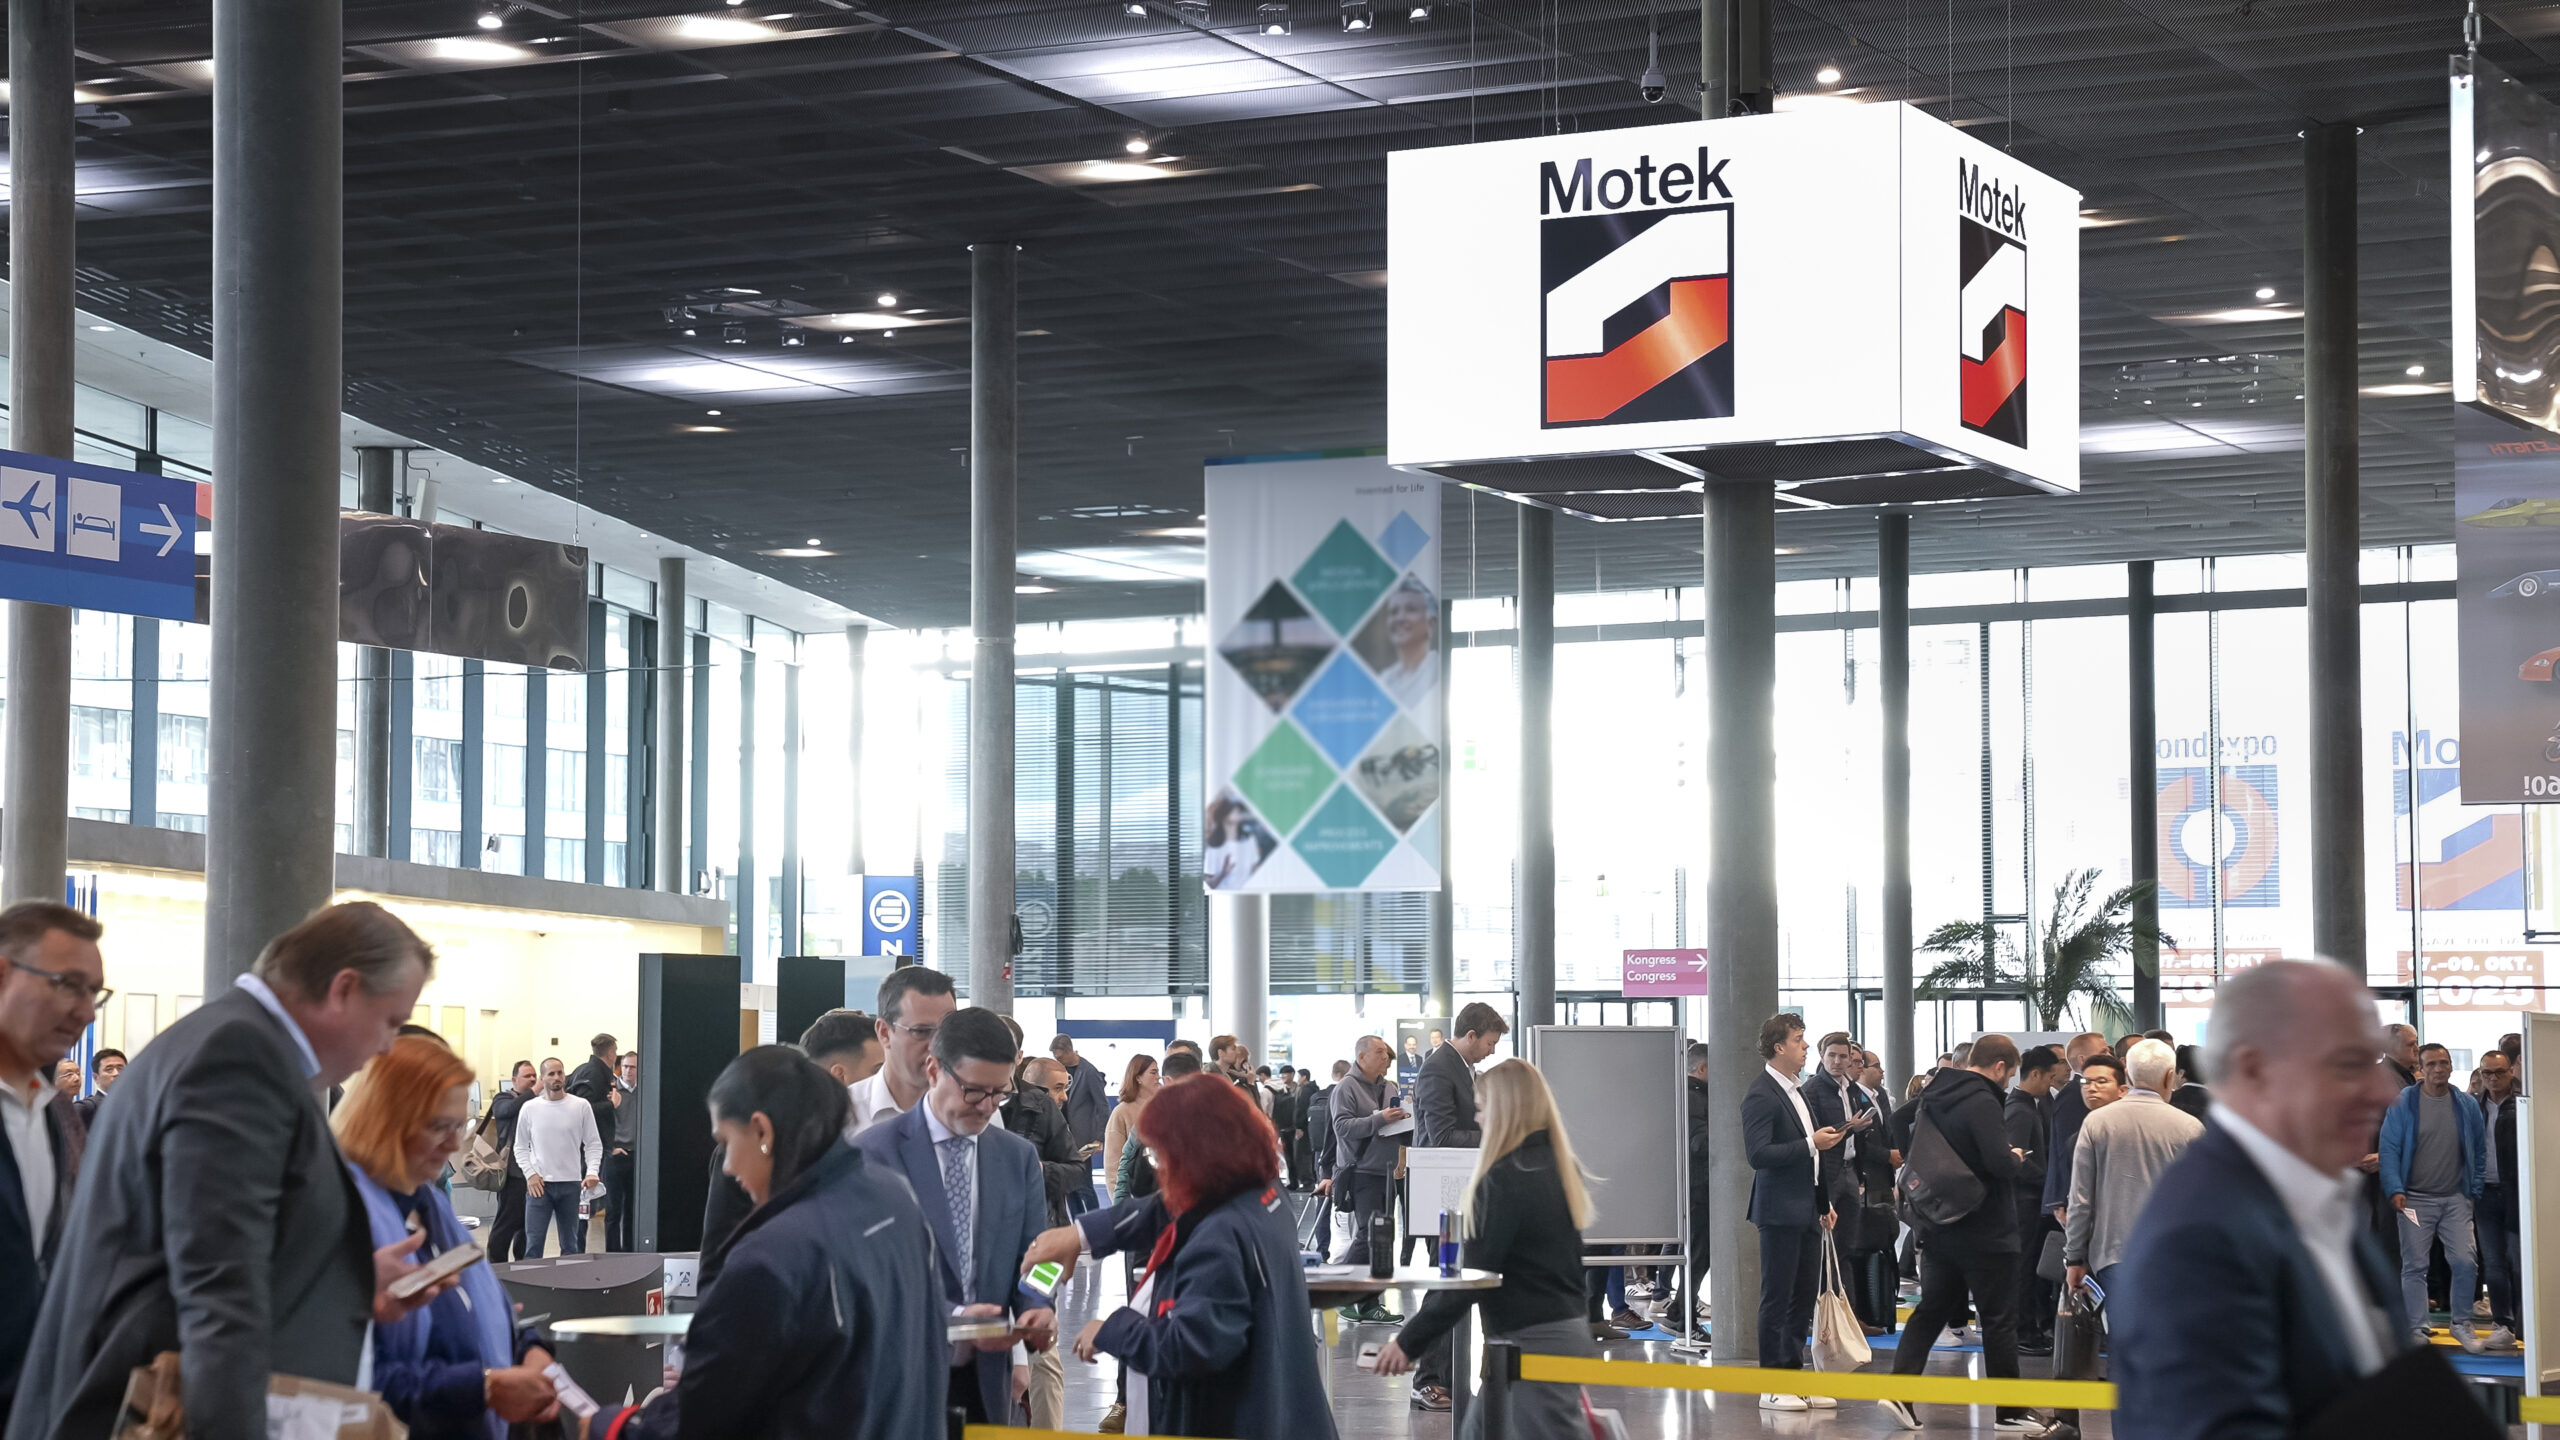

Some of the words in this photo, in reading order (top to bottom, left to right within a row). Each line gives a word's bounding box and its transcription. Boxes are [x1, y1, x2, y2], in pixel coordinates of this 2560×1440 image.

[1541, 146, 1732, 215] Motek
[1959, 156, 2026, 241] Motek
[2156, 731, 2277, 762] ondxpo
[2392, 730, 2460, 765] Mo
[1626, 954, 1677, 967] Kongress
[2484, 956, 2534, 972] OKT.
[1626, 970, 1677, 984] Congress
